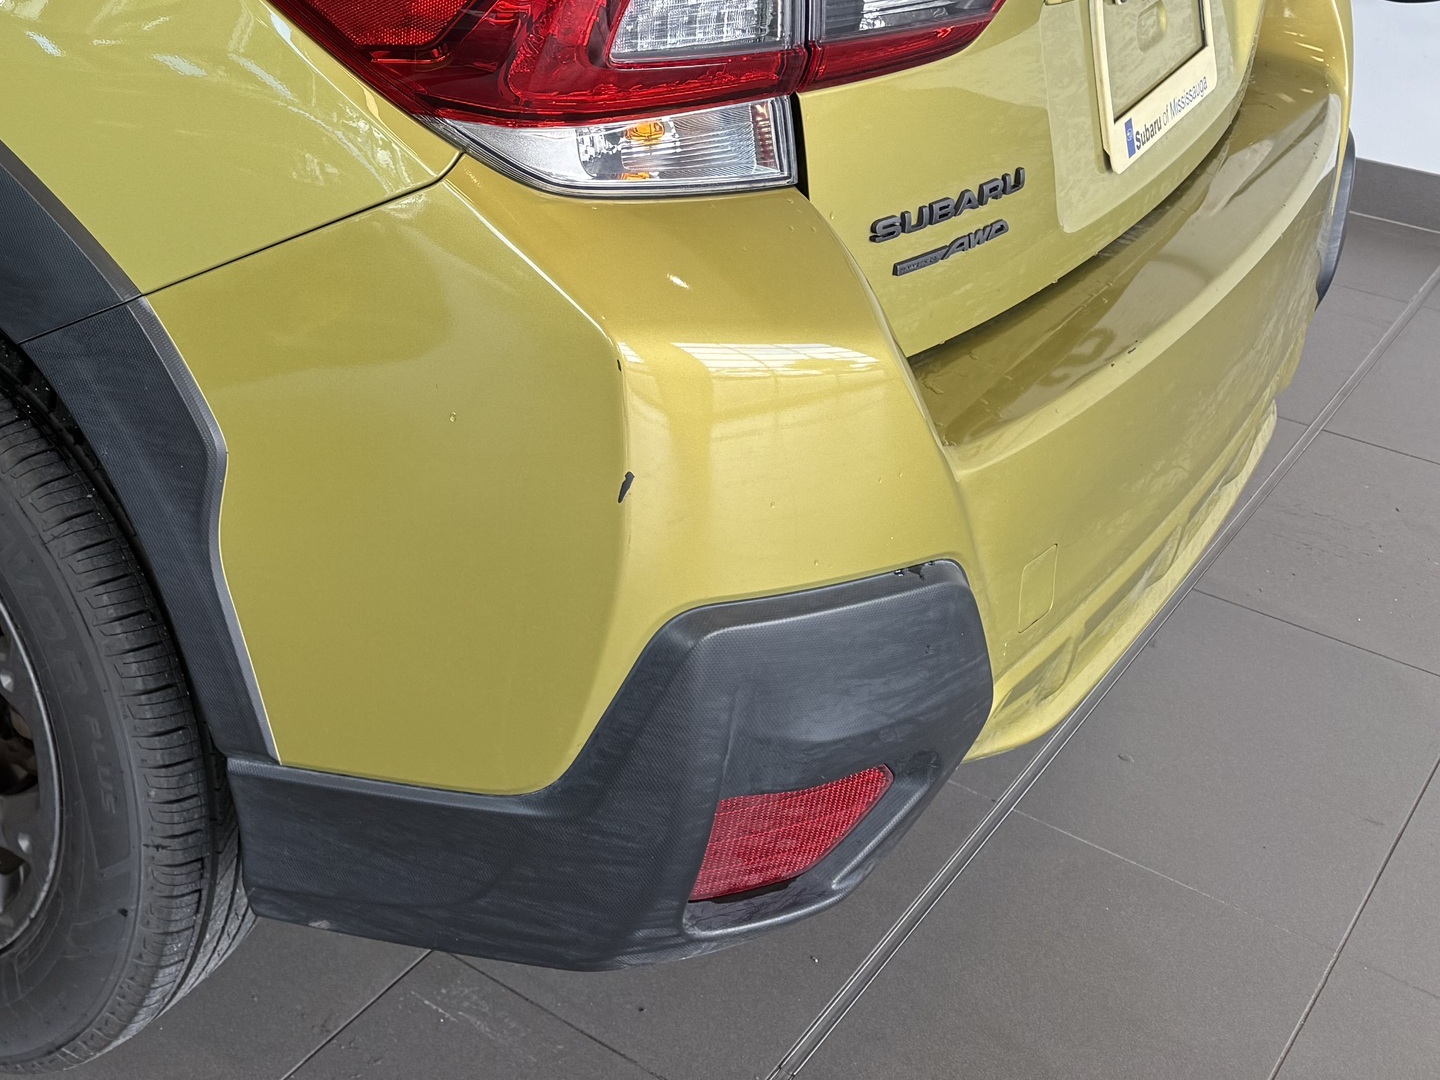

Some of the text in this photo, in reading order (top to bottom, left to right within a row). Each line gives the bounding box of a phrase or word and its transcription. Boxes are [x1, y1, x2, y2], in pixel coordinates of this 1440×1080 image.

[1135, 76, 1208, 151] Subaru of Mississauga
[868, 166, 1026, 244] SUBARU
[941, 218, 1010, 260] AWD
